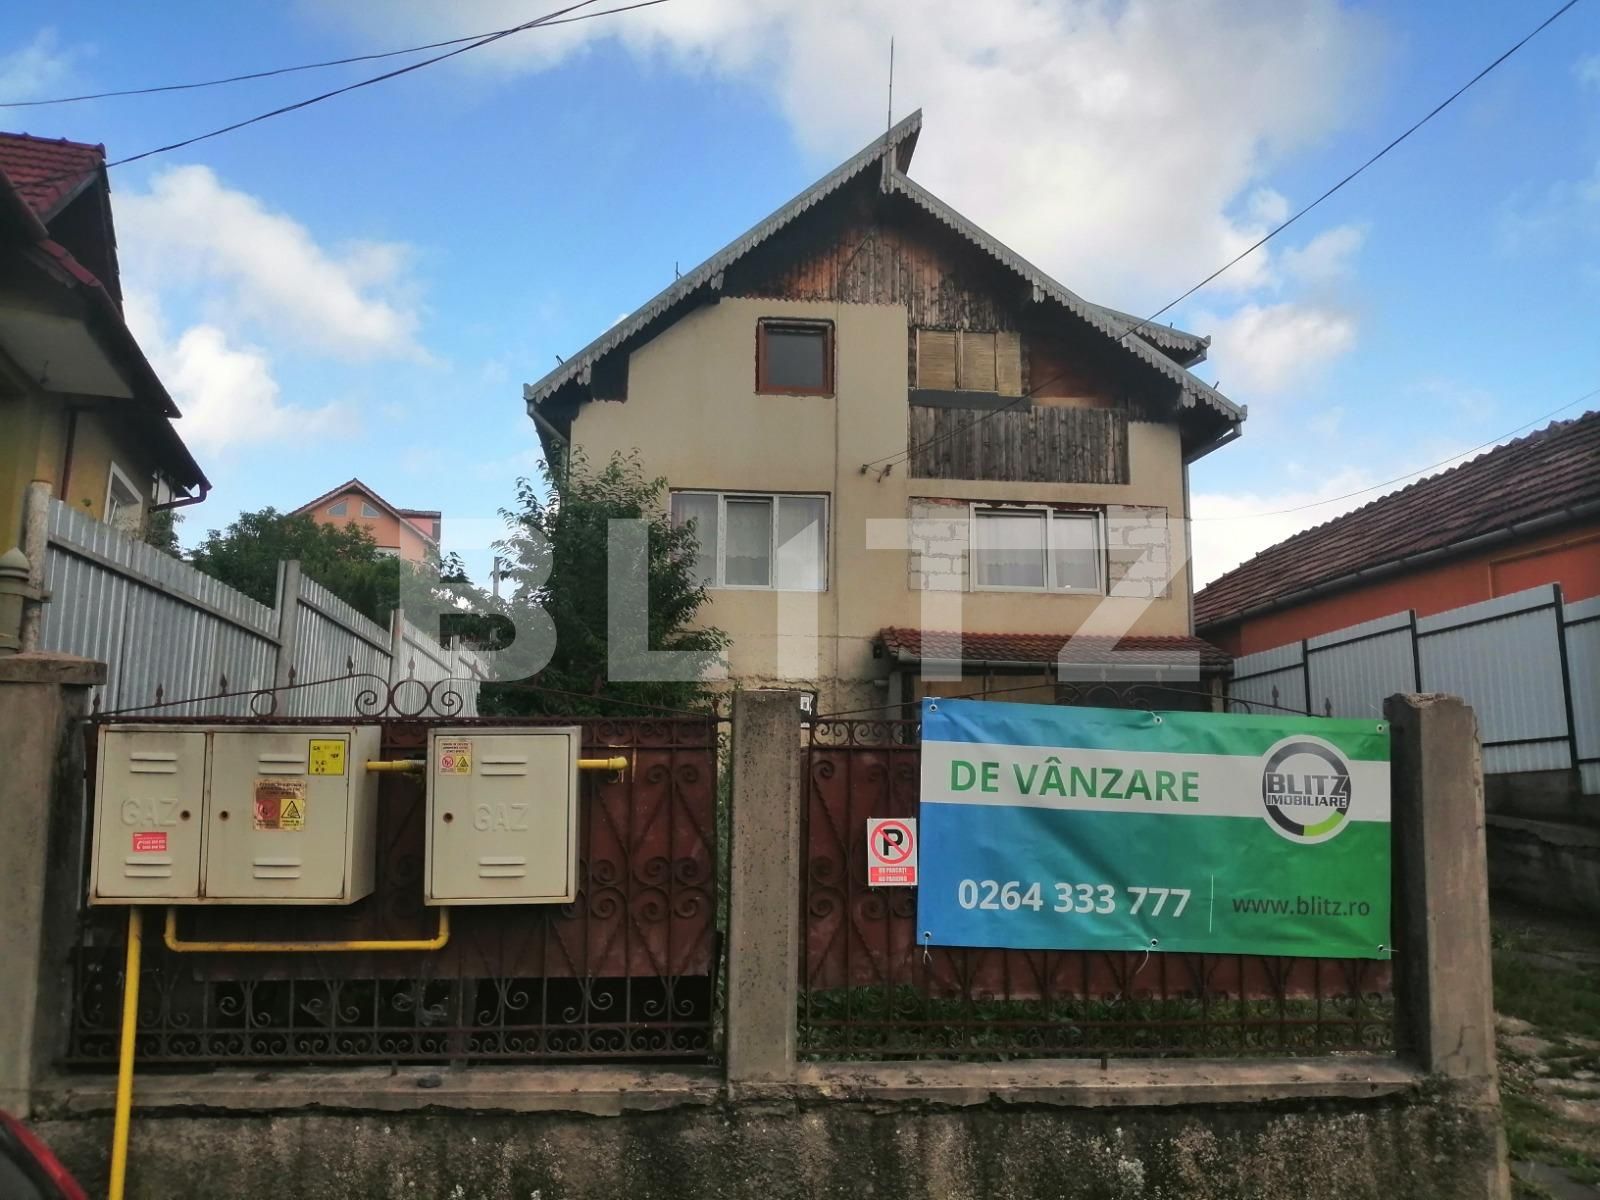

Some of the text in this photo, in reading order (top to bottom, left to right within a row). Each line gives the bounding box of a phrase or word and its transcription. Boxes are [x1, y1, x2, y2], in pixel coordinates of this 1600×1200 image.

[950, 756, 1200, 803] DE VÂNZARE
[1266, 773, 1348, 796] BLITZ
[120, 798, 178, 828] GAZ
[1266, 795, 1346, 808] IMOBILIARE
[473, 802, 529, 832] GAZ
[958, 879, 1191, 917] 0264 333 777
[1232, 895, 1371, 916] www.blitz.ro
